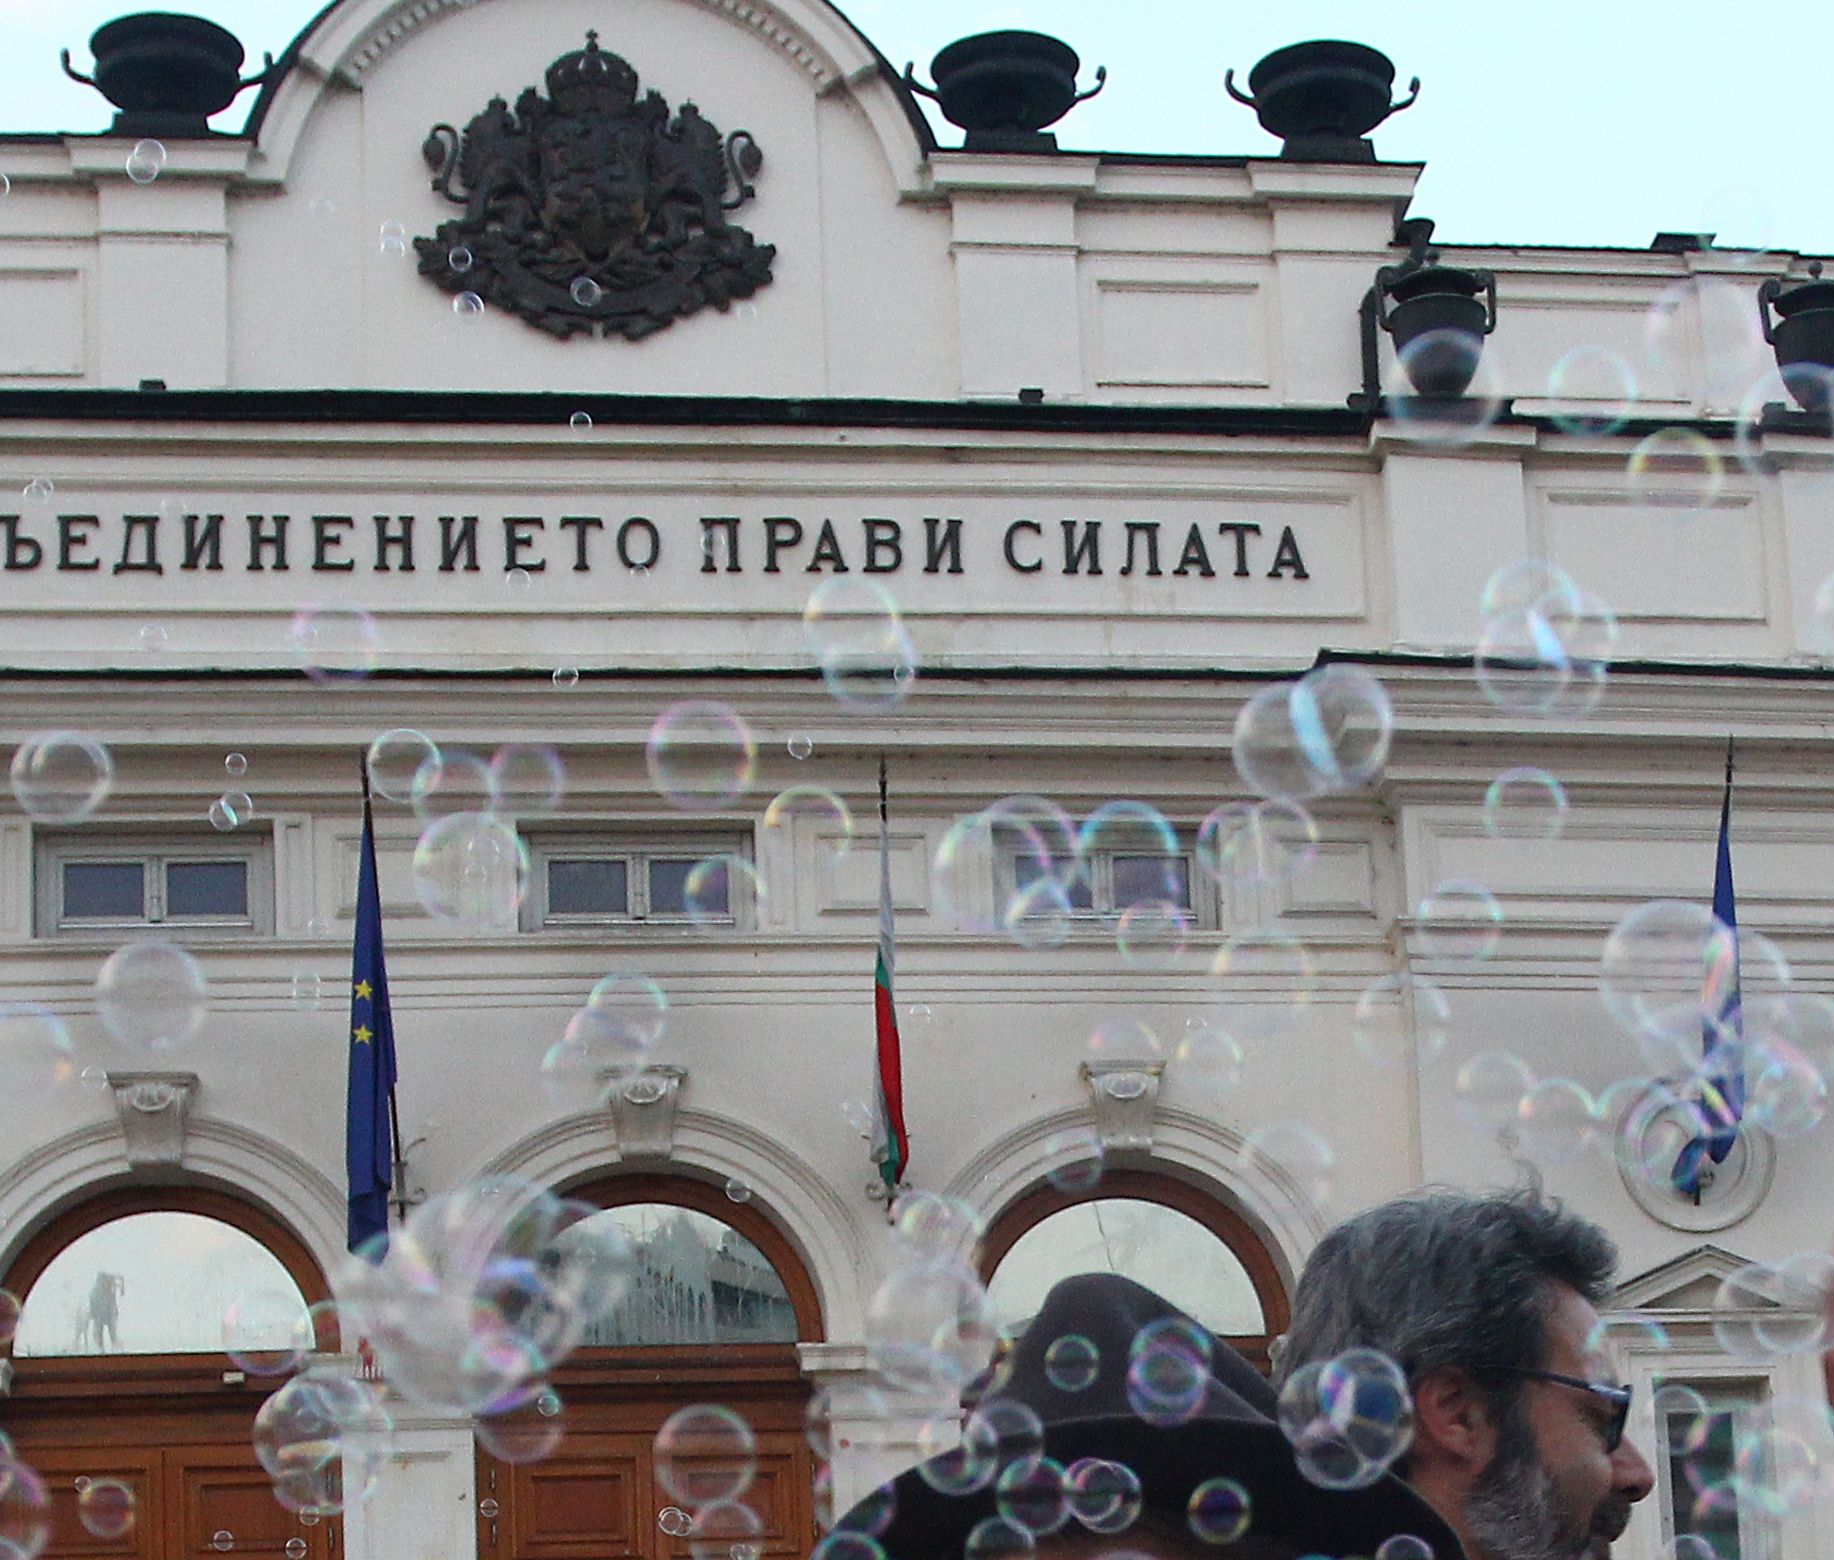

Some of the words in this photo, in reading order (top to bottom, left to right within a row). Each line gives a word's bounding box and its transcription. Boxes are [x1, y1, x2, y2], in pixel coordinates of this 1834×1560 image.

[0, 513, 660, 576] ЪЕДИНЕНИЕТО
[699, 516, 966, 574] ПРАВИ
[1002, 519, 1311, 580] СИЛАТА
